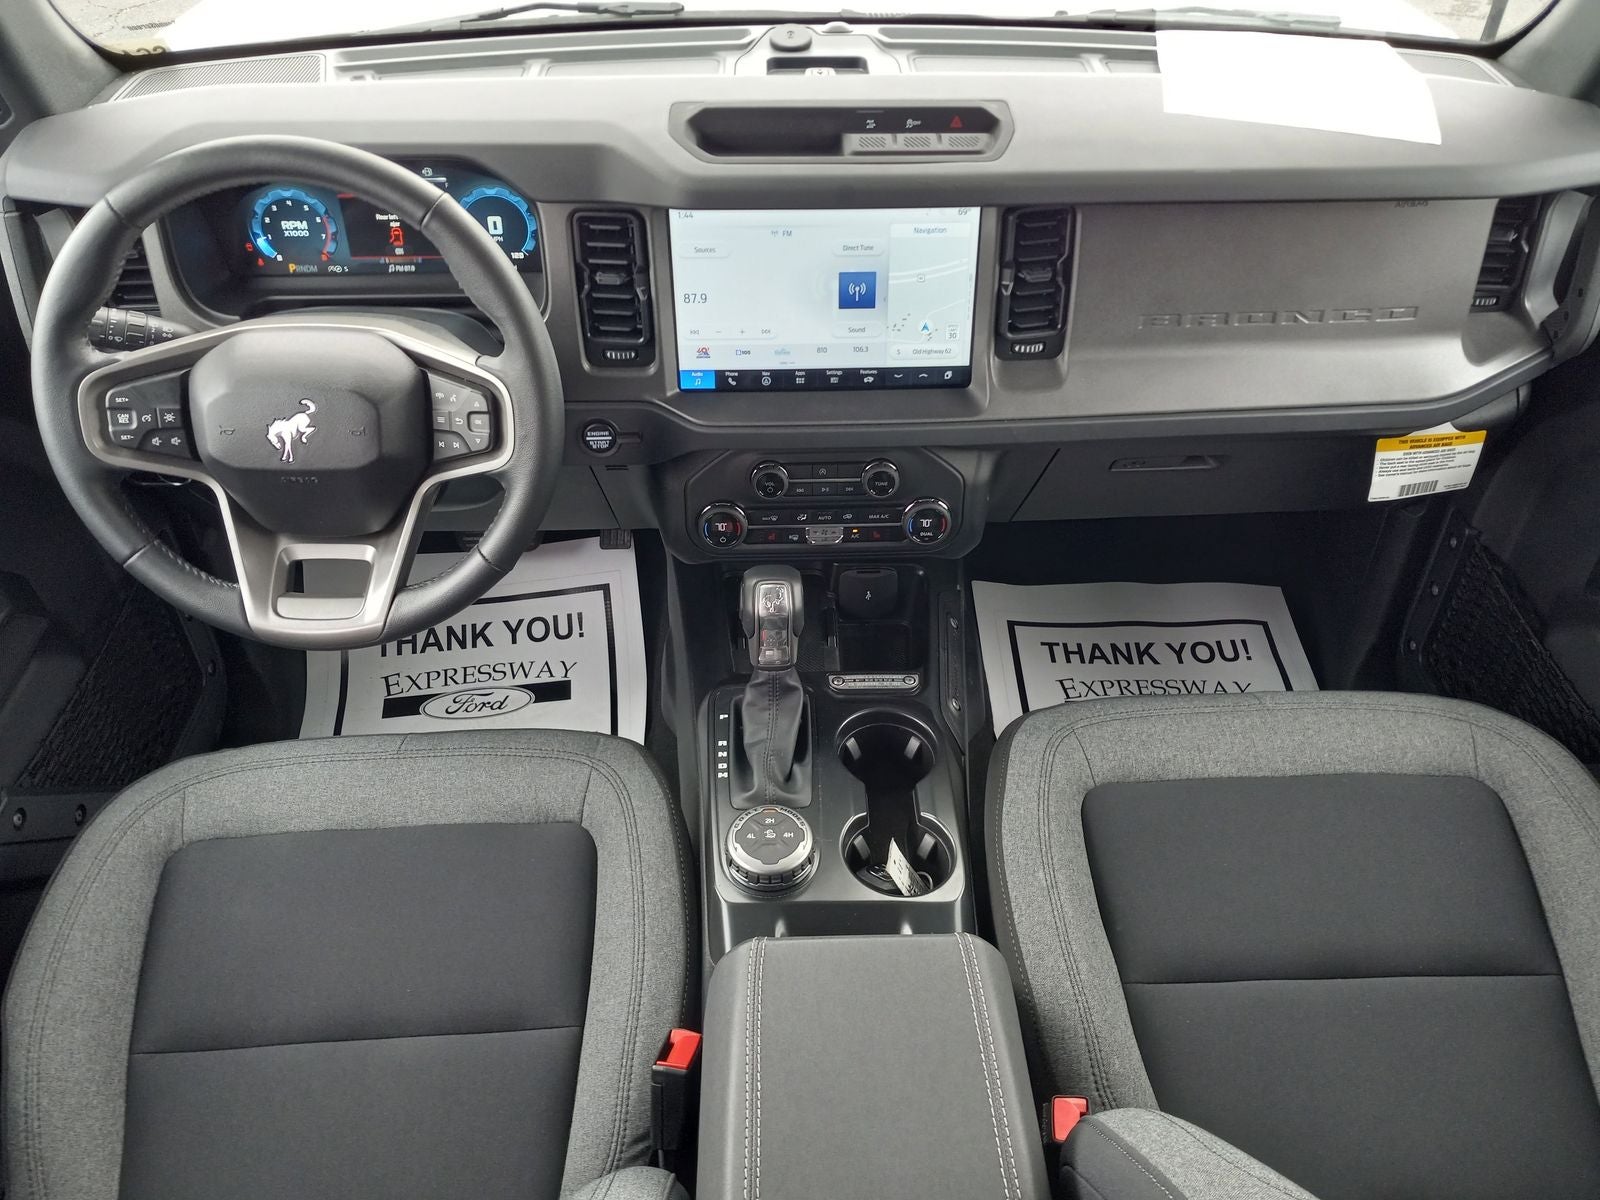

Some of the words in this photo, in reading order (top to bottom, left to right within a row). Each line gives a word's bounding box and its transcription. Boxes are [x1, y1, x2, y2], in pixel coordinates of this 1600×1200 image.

[281, 220, 308, 230] RPM
[487, 216, 504, 235] 0
[683, 292, 708, 304] 87.9
[1138, 306, 1418, 329] BRONCO
[502, 612, 585, 645] YOU!
[1040, 642, 1160, 665] THANK
[1165, 638, 1252, 664] YOU!
[444, 692, 509, 714] Ford
